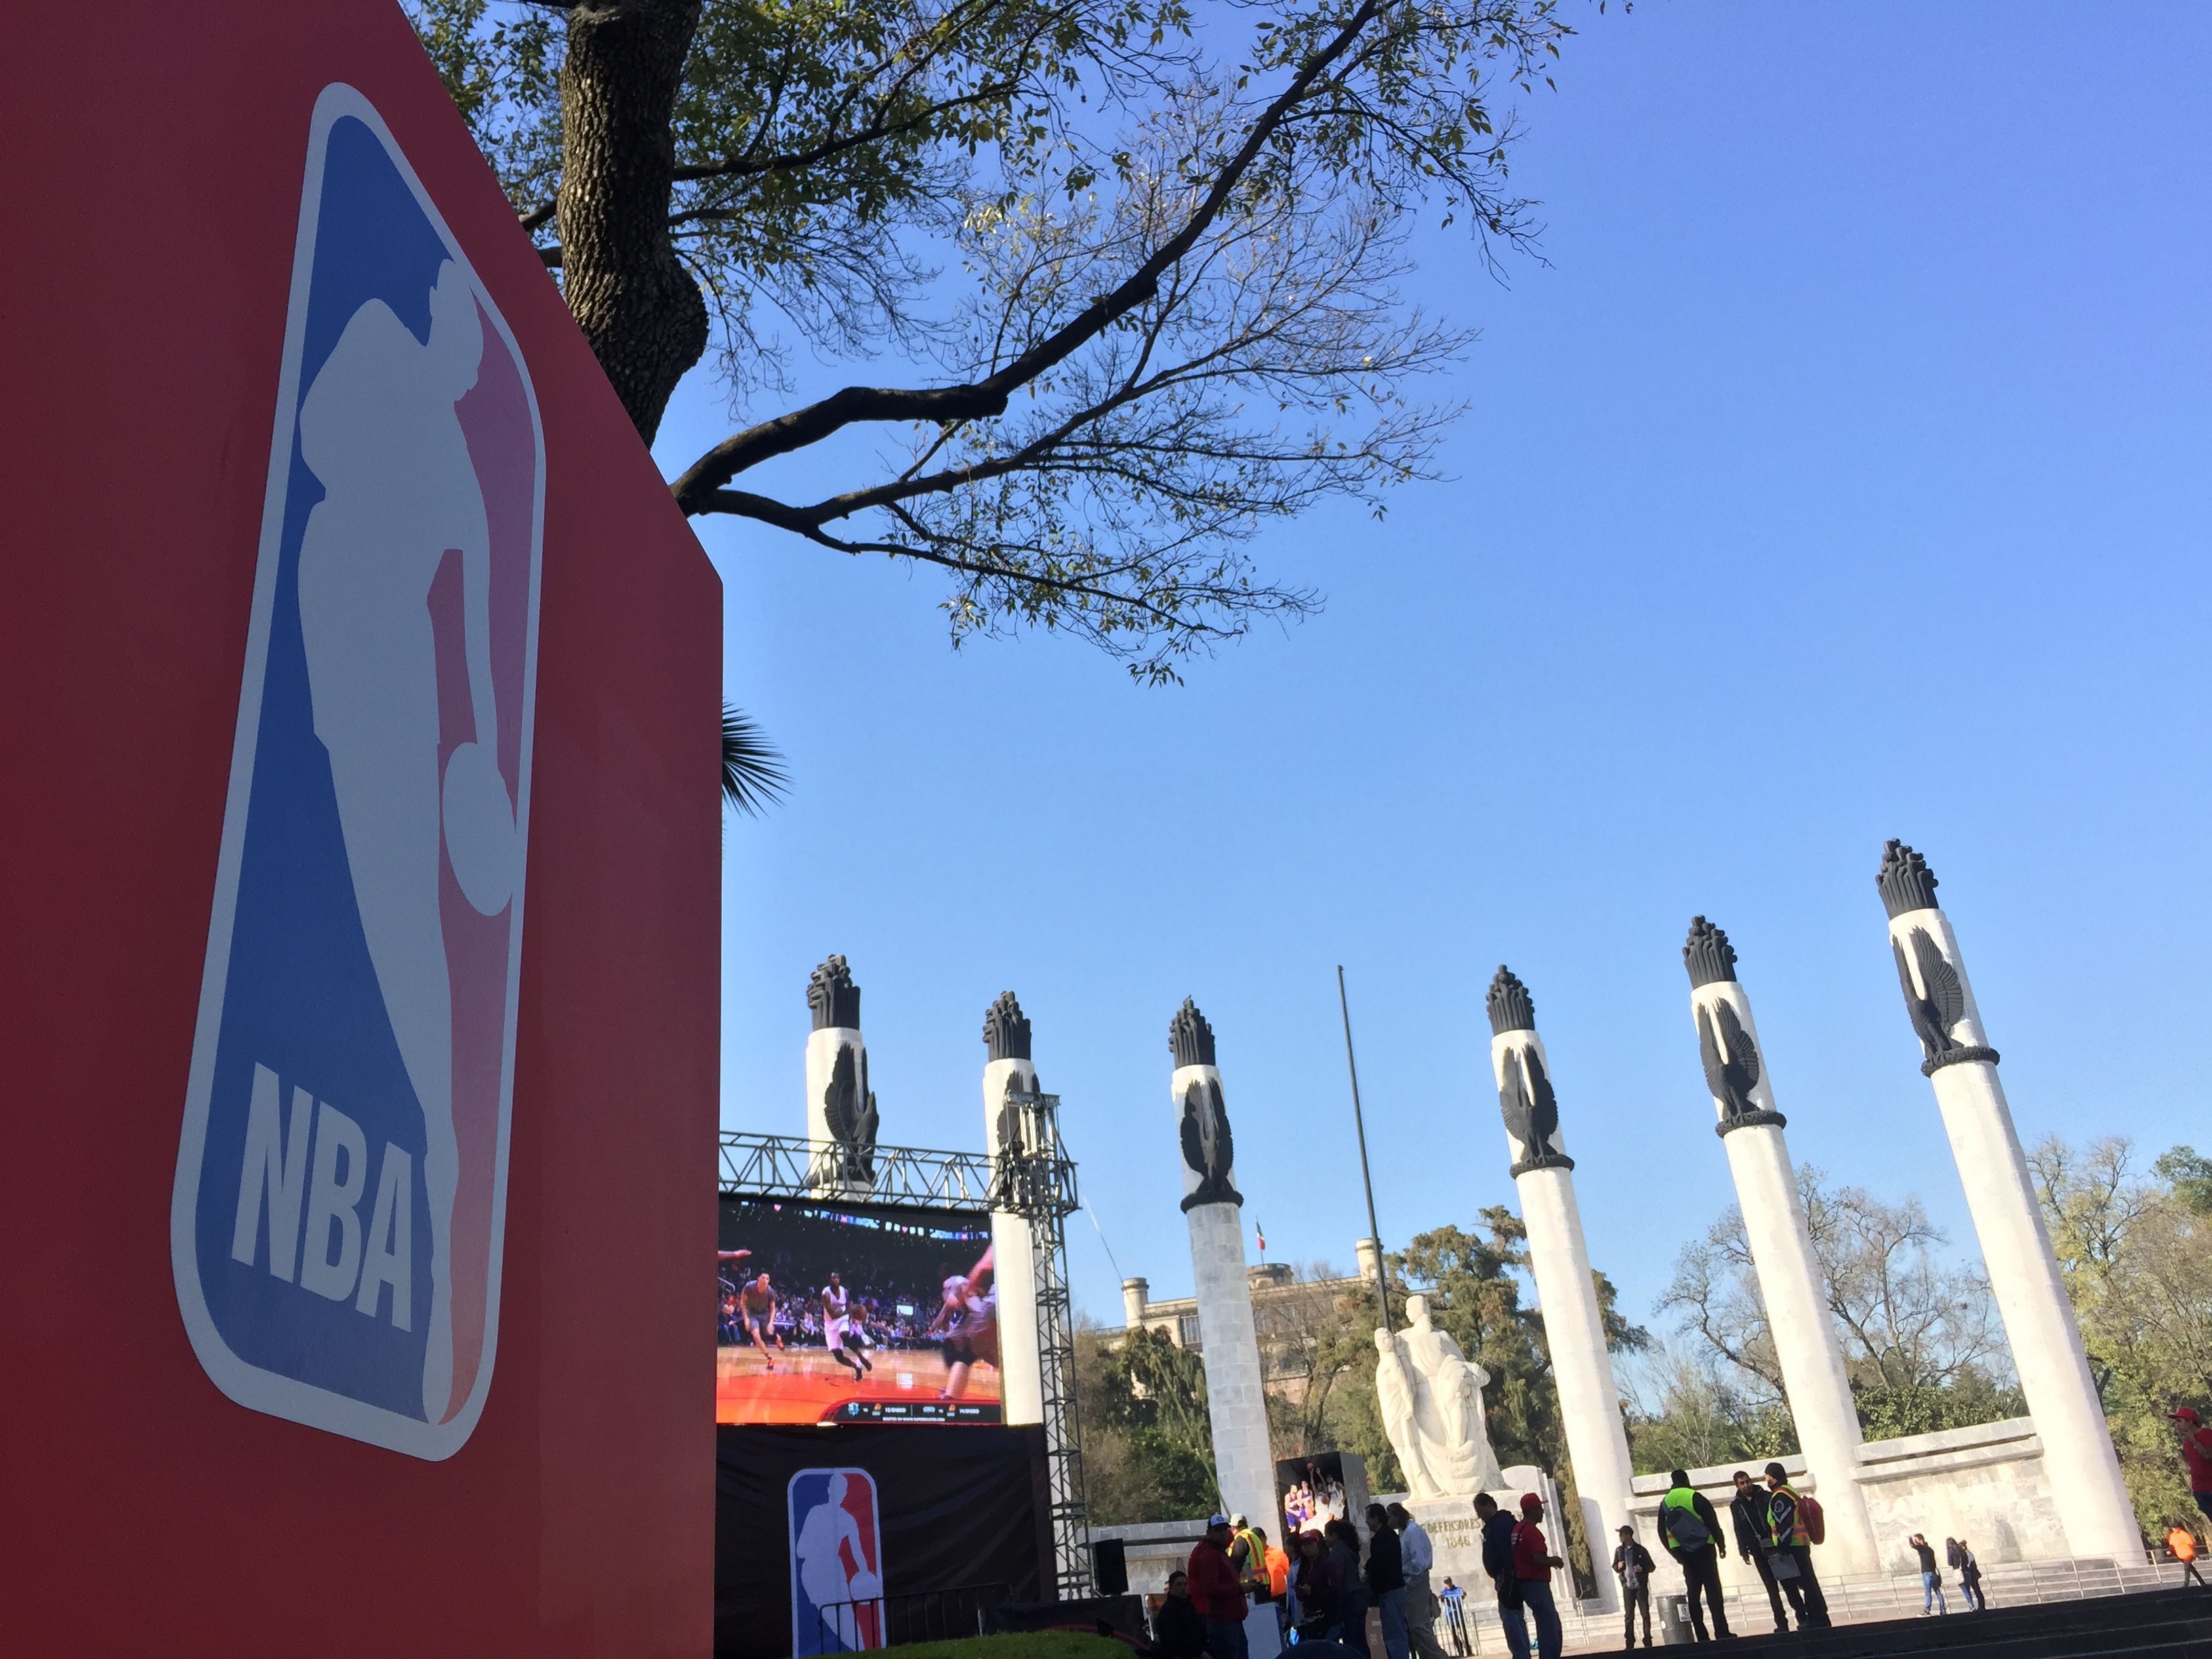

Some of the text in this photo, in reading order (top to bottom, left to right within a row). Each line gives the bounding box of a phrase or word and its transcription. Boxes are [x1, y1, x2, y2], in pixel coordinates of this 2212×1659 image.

[231, 1061, 411, 1333] NBA
[1427, 1518, 1481, 1534] DEFENSORES
[1446, 1535, 1471, 1549] 1846
